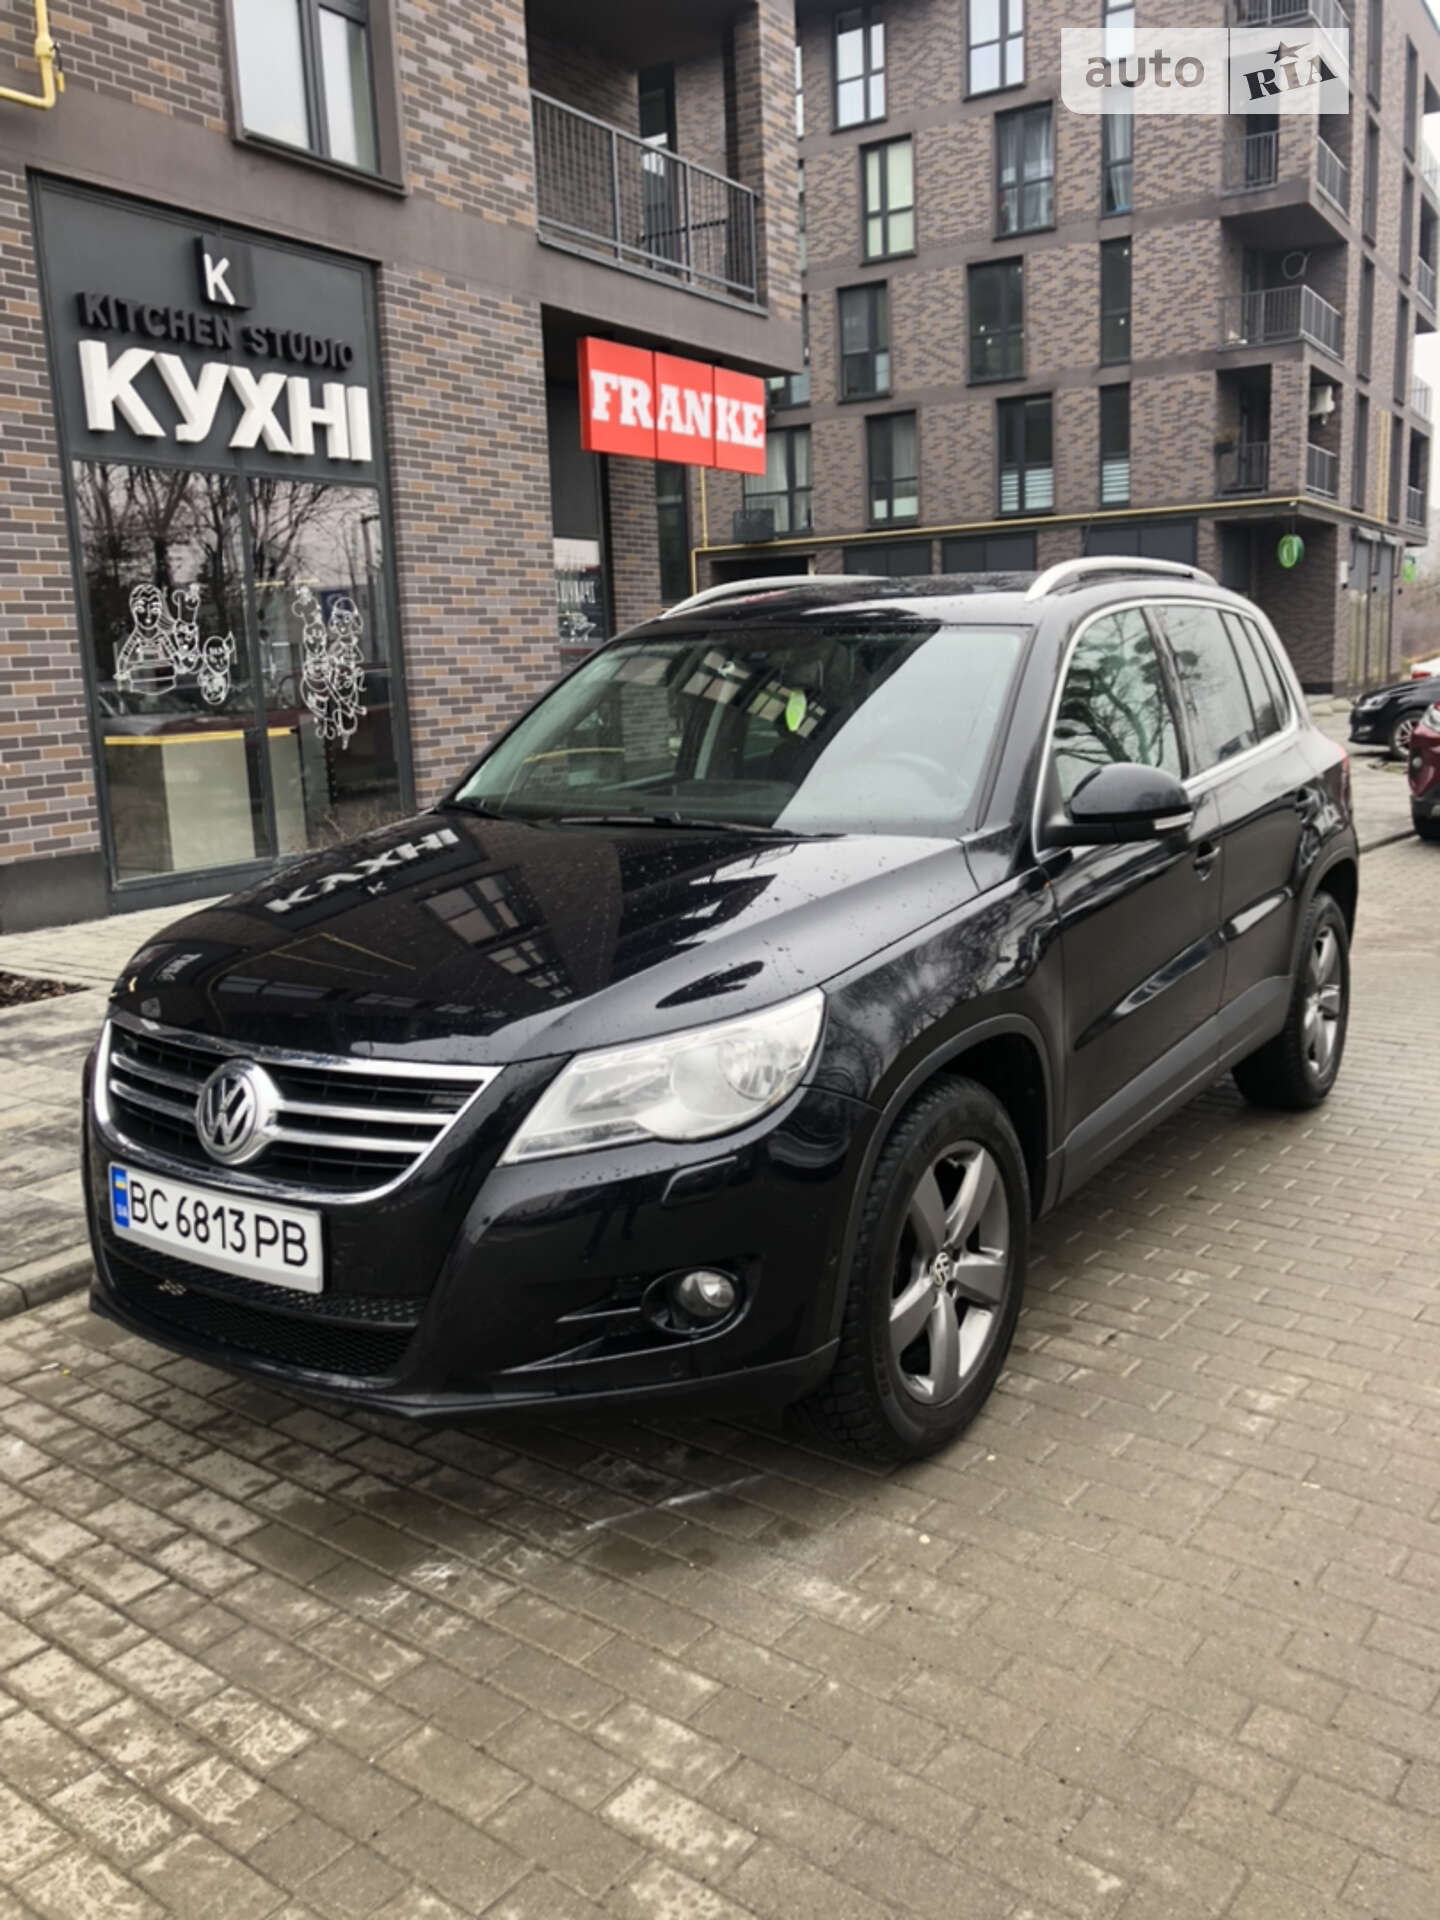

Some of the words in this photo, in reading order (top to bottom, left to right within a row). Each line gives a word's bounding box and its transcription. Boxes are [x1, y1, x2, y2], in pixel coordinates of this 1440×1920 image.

[203, 253, 236, 305] K
[78, 291, 237, 351] KITCHEN
[245, 323, 355, 370] STUDIO
[79, 339, 373, 462] КУХНІ
[589, 368, 765, 449] FRANKE
[129, 1181, 168, 1231] BC
[175, 1196, 247, 1253] 6813
[254, 1214, 309, 1267] PB
